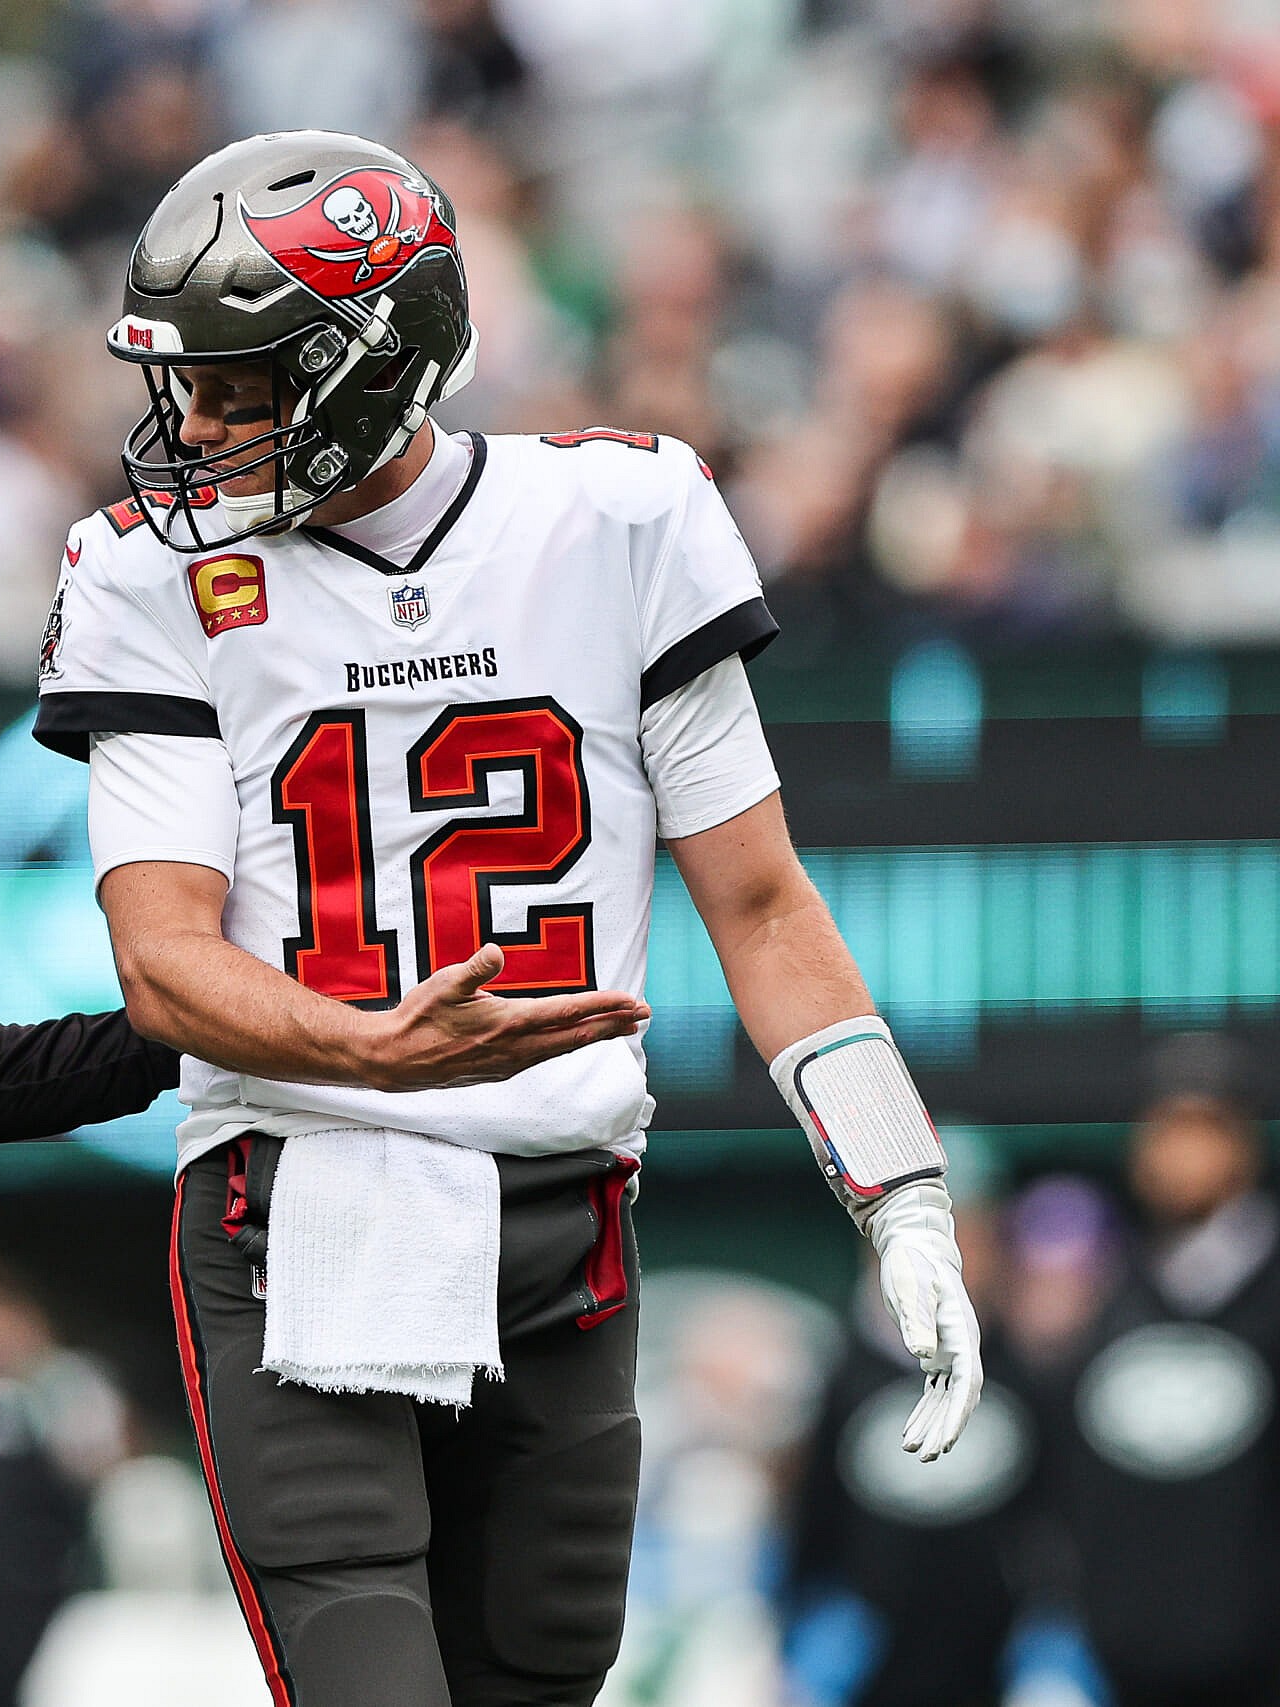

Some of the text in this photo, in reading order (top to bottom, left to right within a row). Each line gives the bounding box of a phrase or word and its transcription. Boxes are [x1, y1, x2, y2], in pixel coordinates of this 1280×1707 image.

[195, 558, 260, 614] C
[396, 601, 425, 621] NFL
[344, 647, 498, 693] BUCCANEERS
[270, 695, 598, 1010] 12
